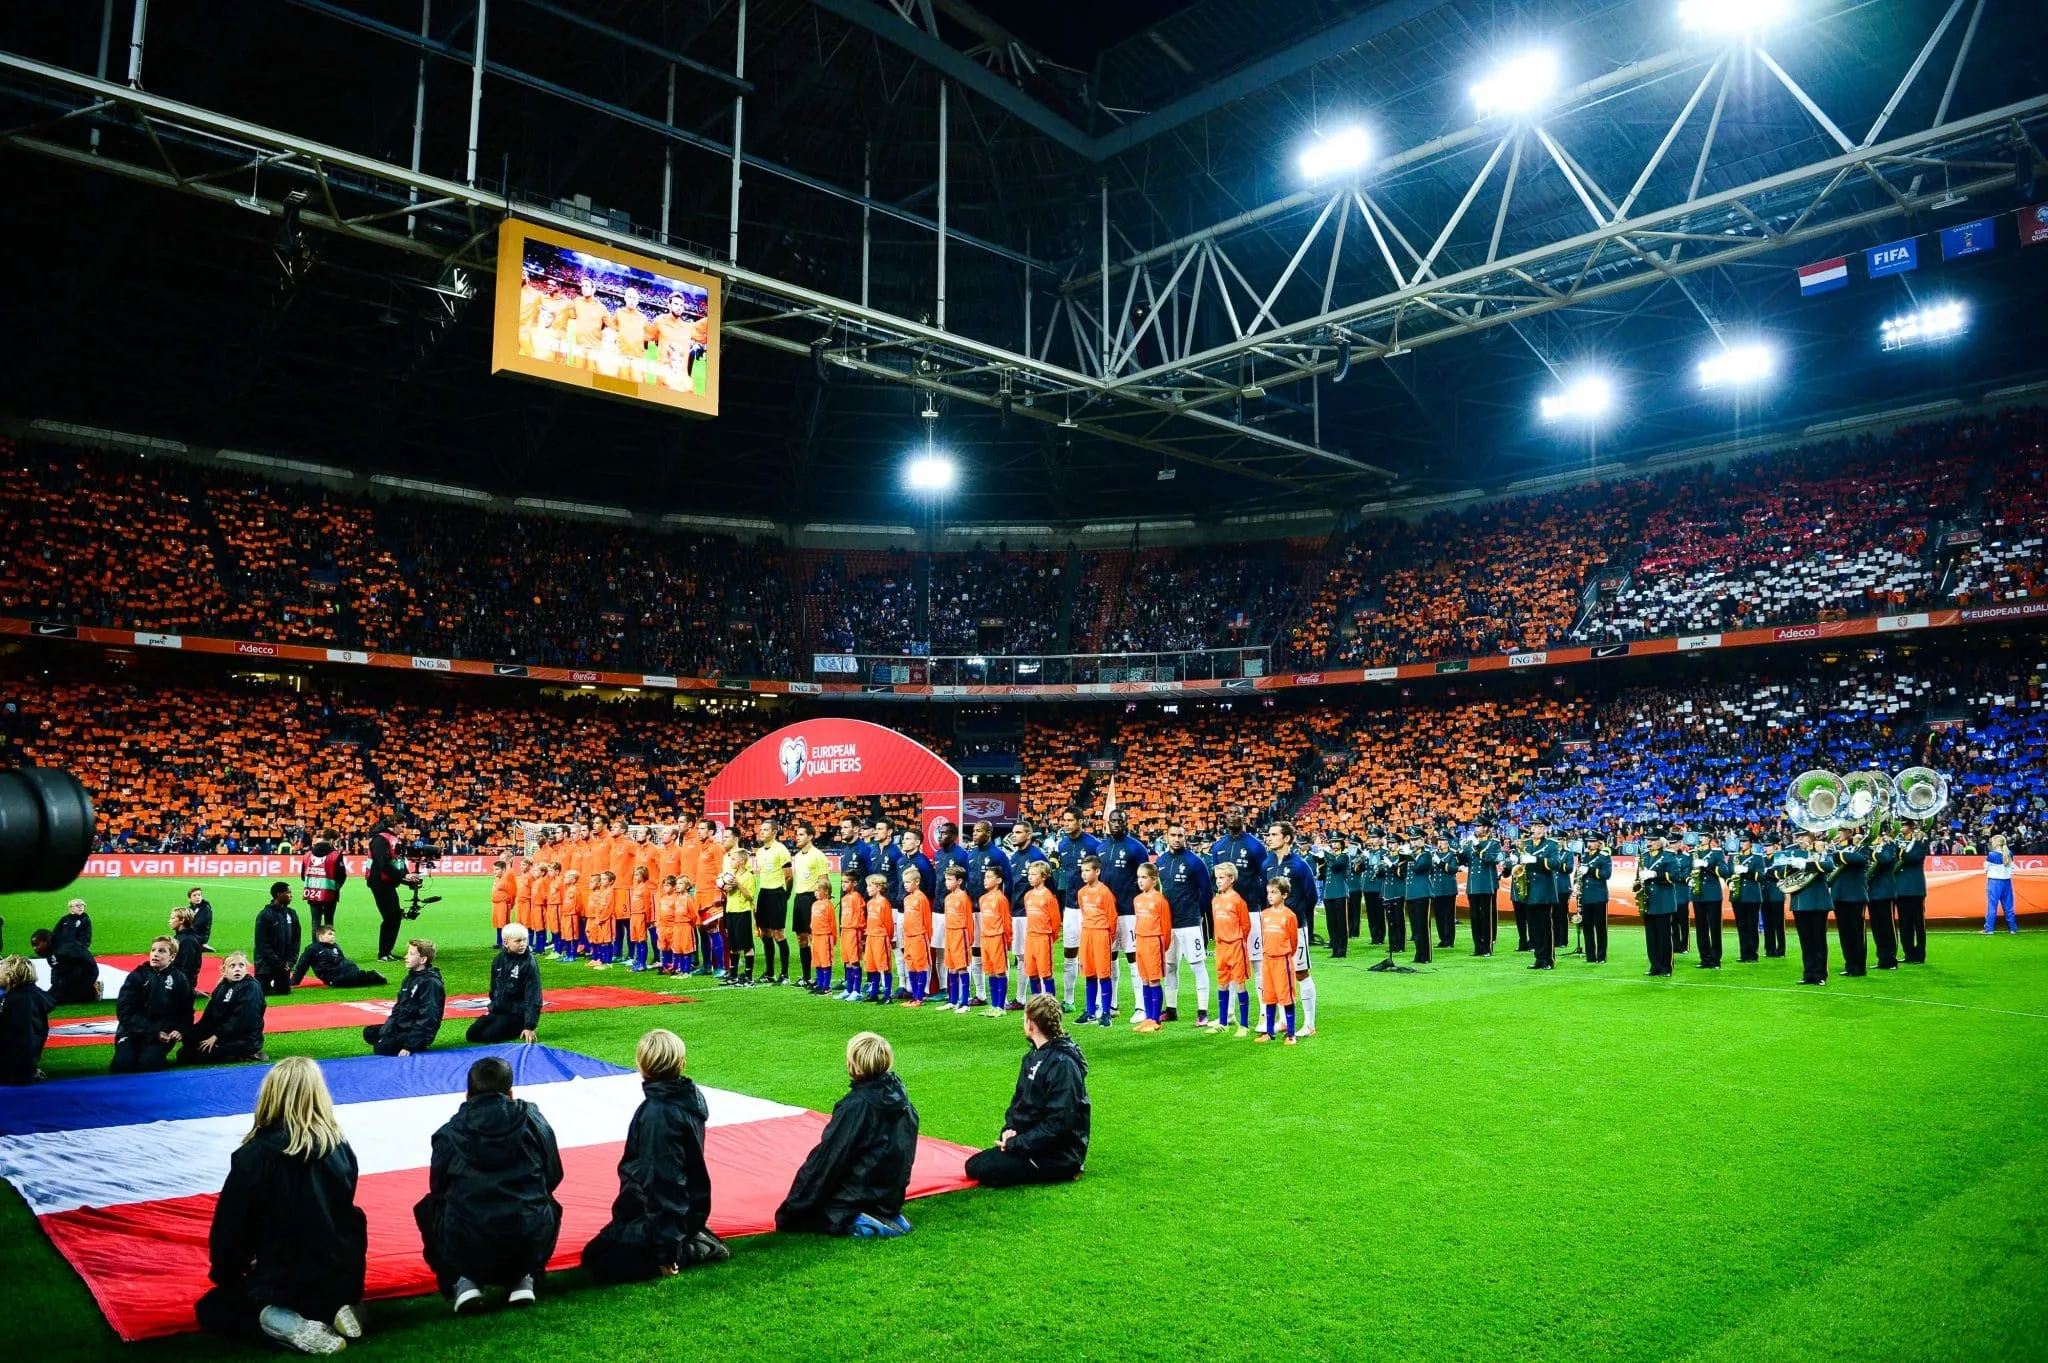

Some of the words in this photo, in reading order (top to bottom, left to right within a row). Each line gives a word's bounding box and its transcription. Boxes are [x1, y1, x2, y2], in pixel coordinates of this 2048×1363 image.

[1874, 247, 1909, 265] FIFA
[1972, 606, 2020, 618] EUROPEAN
[1778, 628, 1816, 639] Adecco
[239, 644, 274, 655] Adecco
[414, 659, 434, 669] ING
[1511, 654, 1530, 664] ING
[791, 684, 808, 692] ING
[812, 744, 856, 759] EUROPEAN
[806, 757, 862, 777] QUALIFIERS
[130, 860, 175, 874] van
[183, 855, 282, 877] Hispanje
[622, 903, 628, 912] 3
[1194, 938, 1201, 950] 8
[1254, 937, 1260, 949] 6
[1297, 947, 1304, 960] 7
